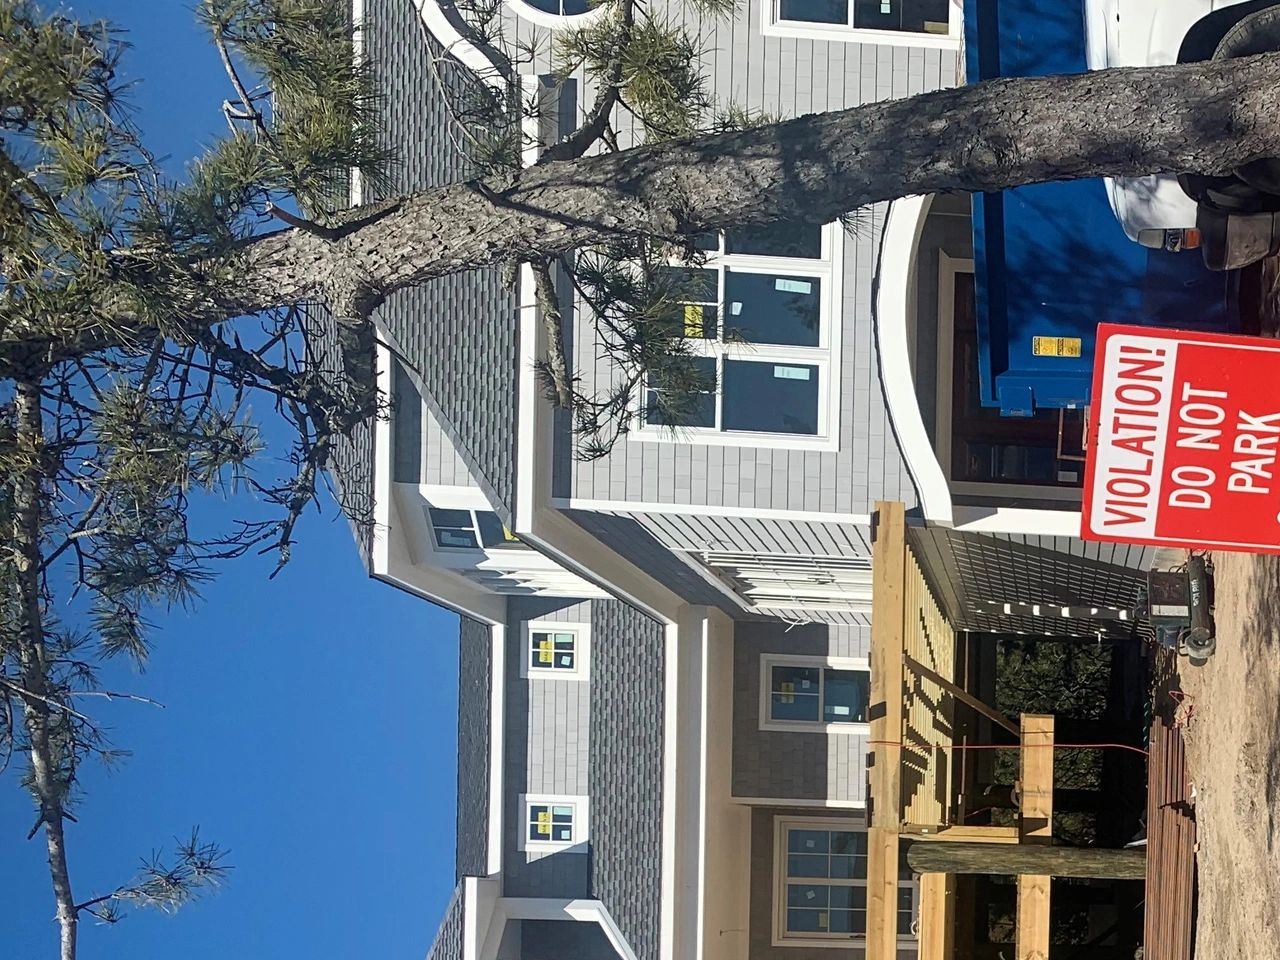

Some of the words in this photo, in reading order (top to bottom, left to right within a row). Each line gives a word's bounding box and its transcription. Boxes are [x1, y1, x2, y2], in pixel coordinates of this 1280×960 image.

[1103, 345, 1165, 526] VIOLATION!
[1176, 381, 1228, 450] NOT
[1168, 465, 1216, 509] DO
